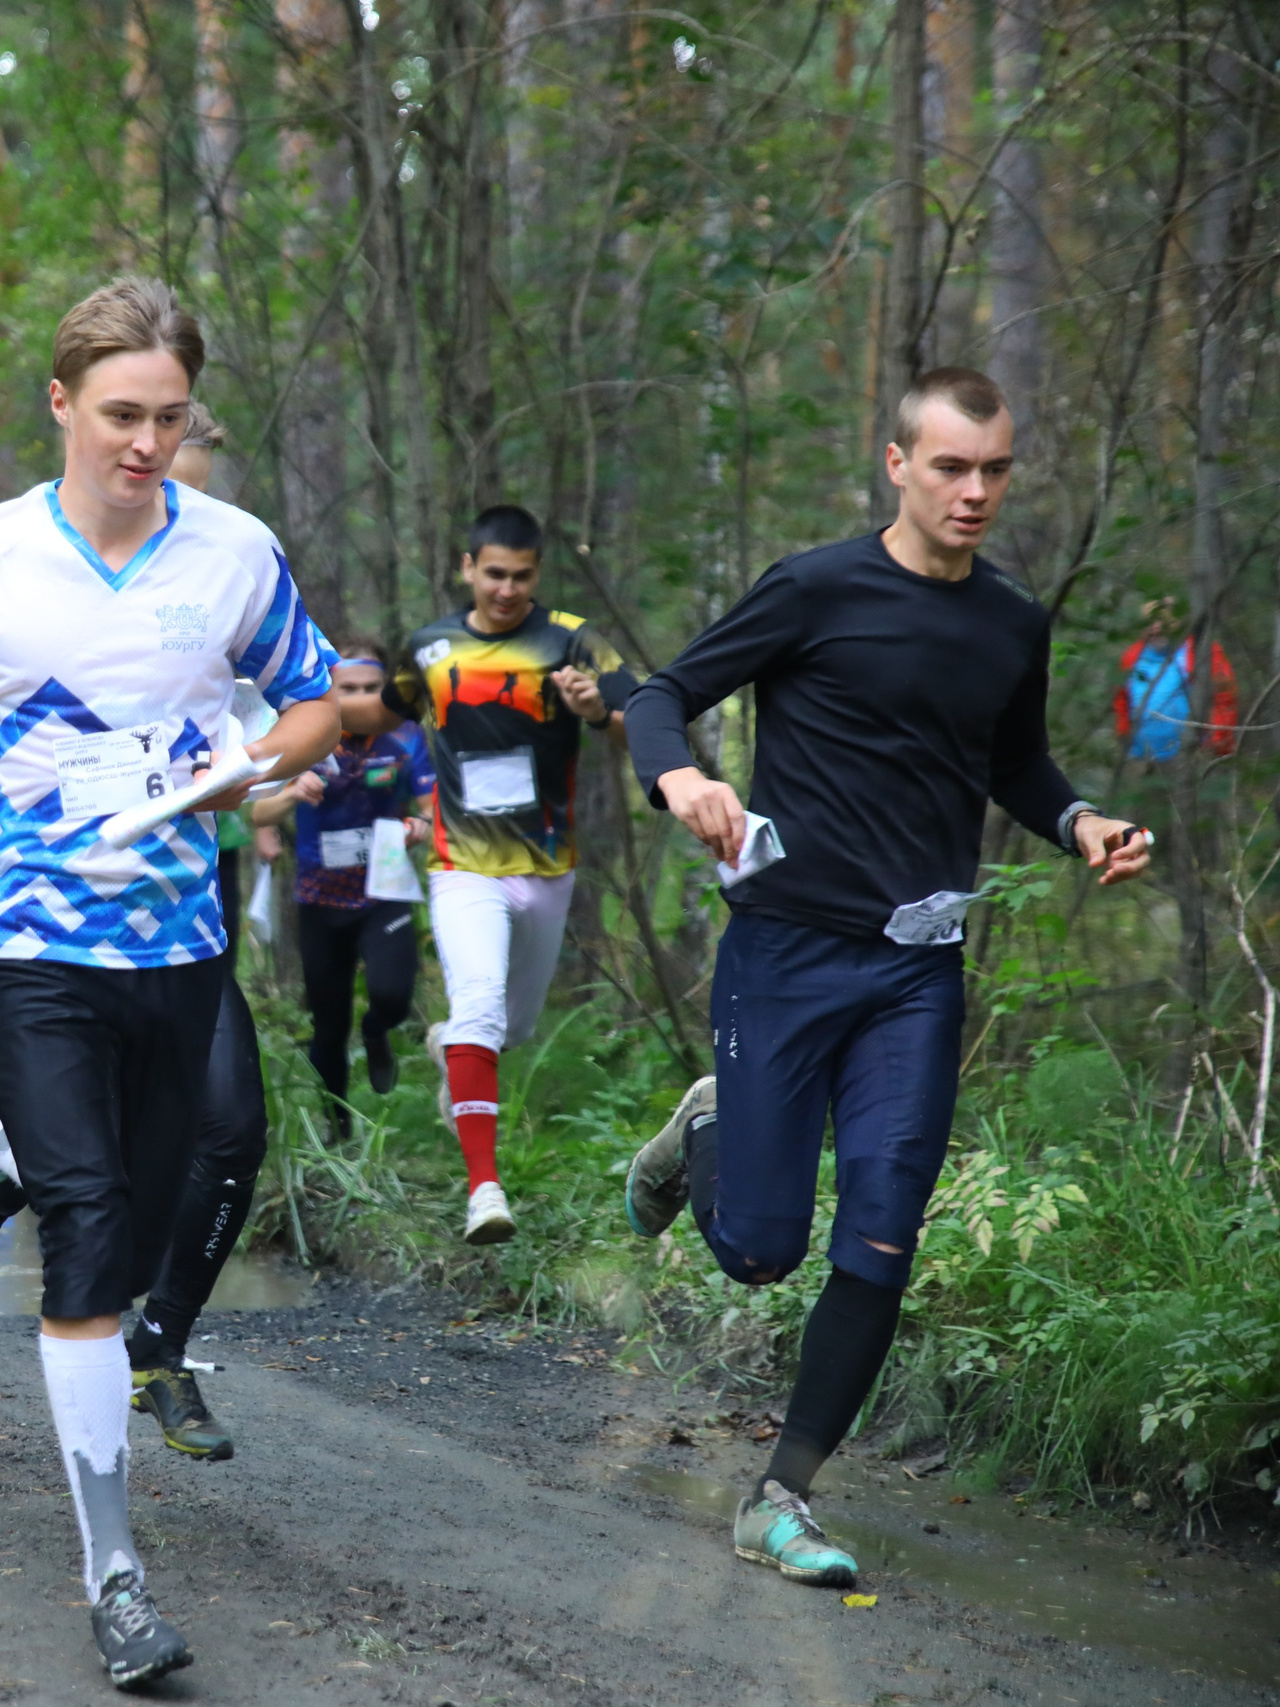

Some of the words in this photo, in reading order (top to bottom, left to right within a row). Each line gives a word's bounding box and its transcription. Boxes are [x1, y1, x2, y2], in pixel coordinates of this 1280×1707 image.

[162, 641, 206, 653] ЮУрГУ
[58, 755, 101, 769] МУЖЧИНЫ
[146, 772, 166, 800] 6
